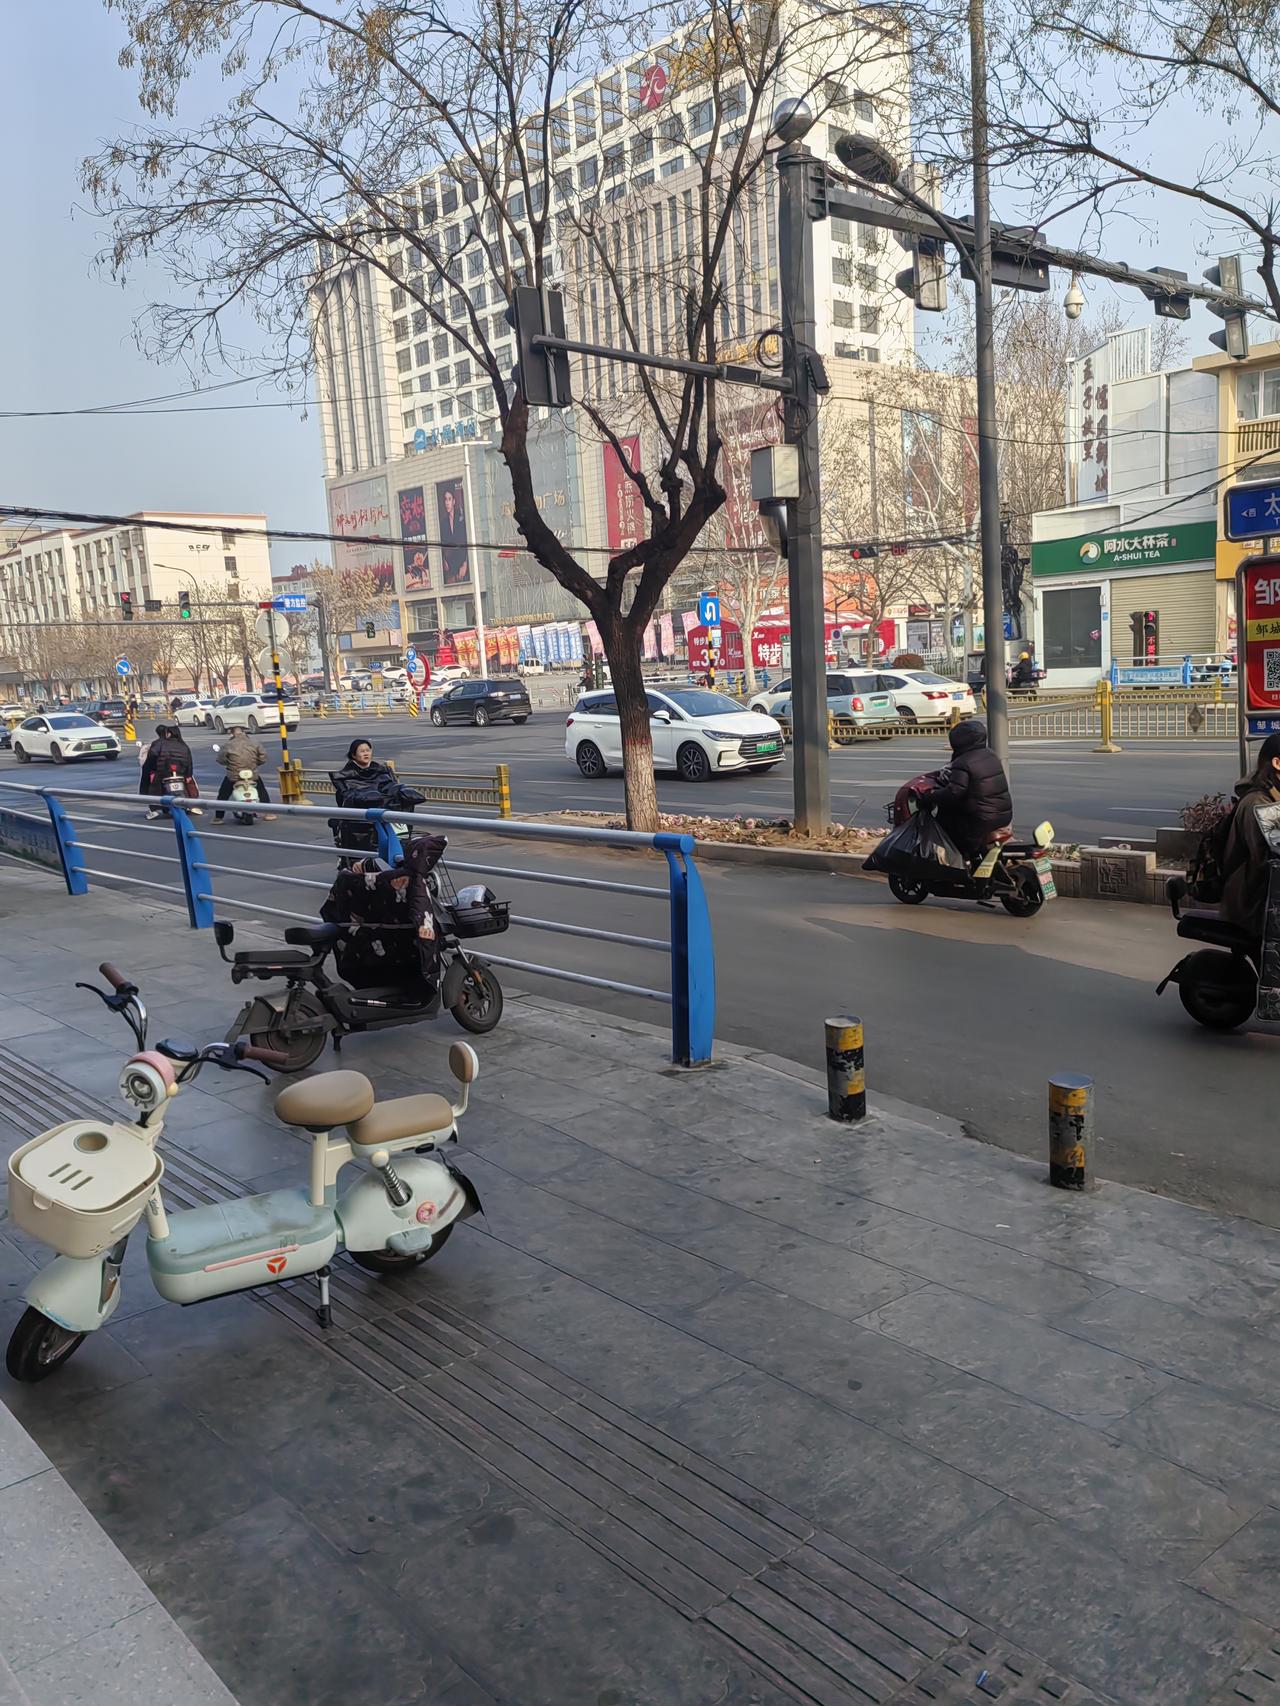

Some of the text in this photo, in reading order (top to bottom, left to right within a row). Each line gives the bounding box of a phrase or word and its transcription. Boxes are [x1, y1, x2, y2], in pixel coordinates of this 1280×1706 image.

[1104, 533, 1169, 554] 阿水大杯茶
[1114, 550, 1160, 562] A-SHUI TEA
